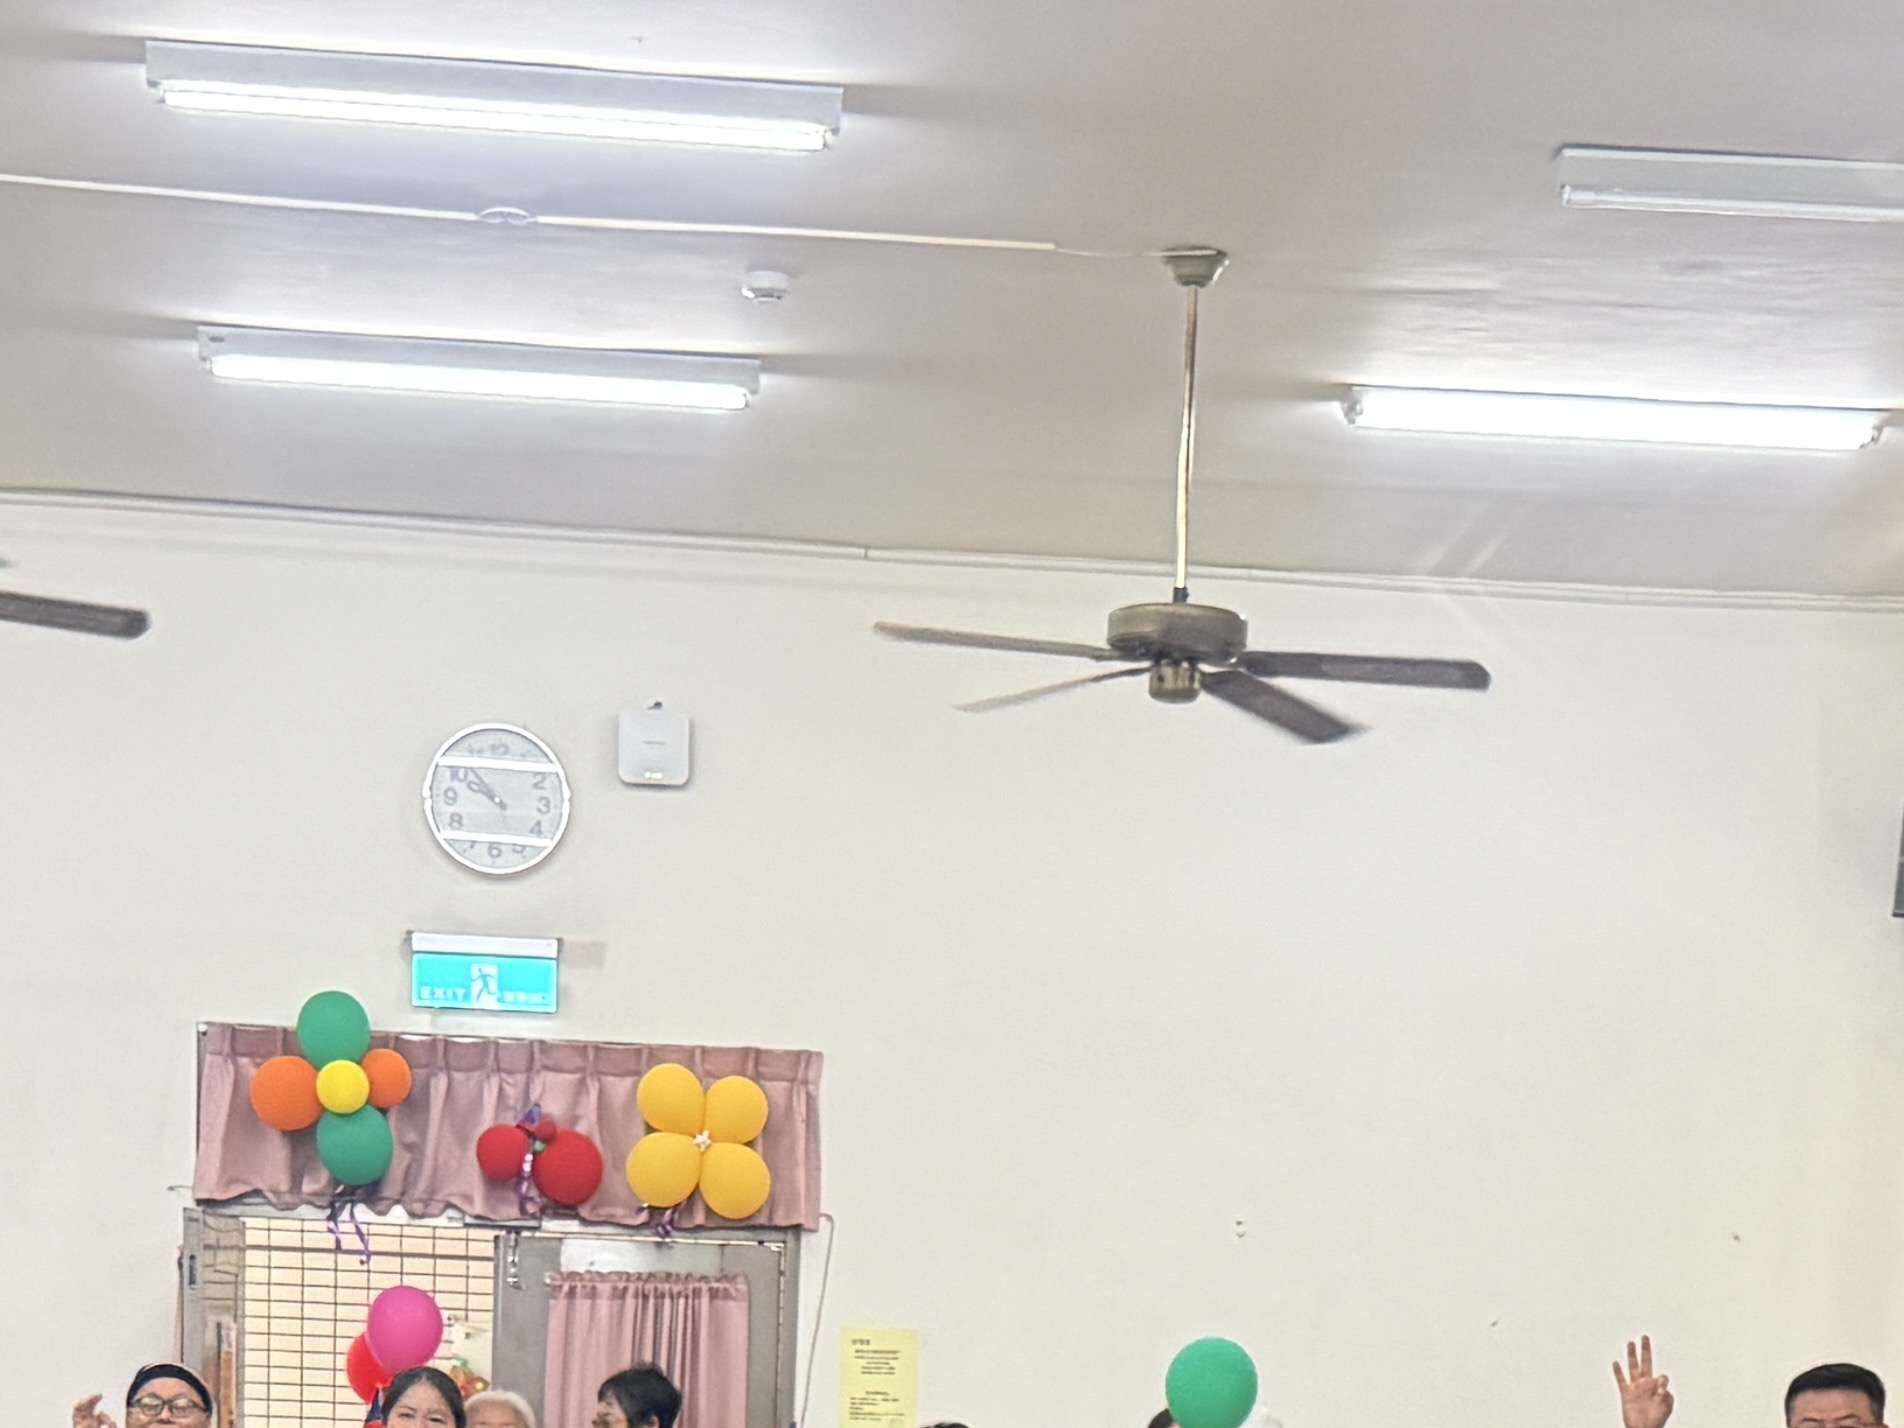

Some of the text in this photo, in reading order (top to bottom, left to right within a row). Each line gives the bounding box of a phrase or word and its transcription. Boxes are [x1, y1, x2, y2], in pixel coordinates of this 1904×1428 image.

[532, 773, 546, 790] 2
[443, 787, 457, 806] 9
[536, 797, 551, 815] 3
[448, 812, 463, 830] 8
[487, 842, 502, 859] 6
[419, 984, 466, 1001] EXIT
